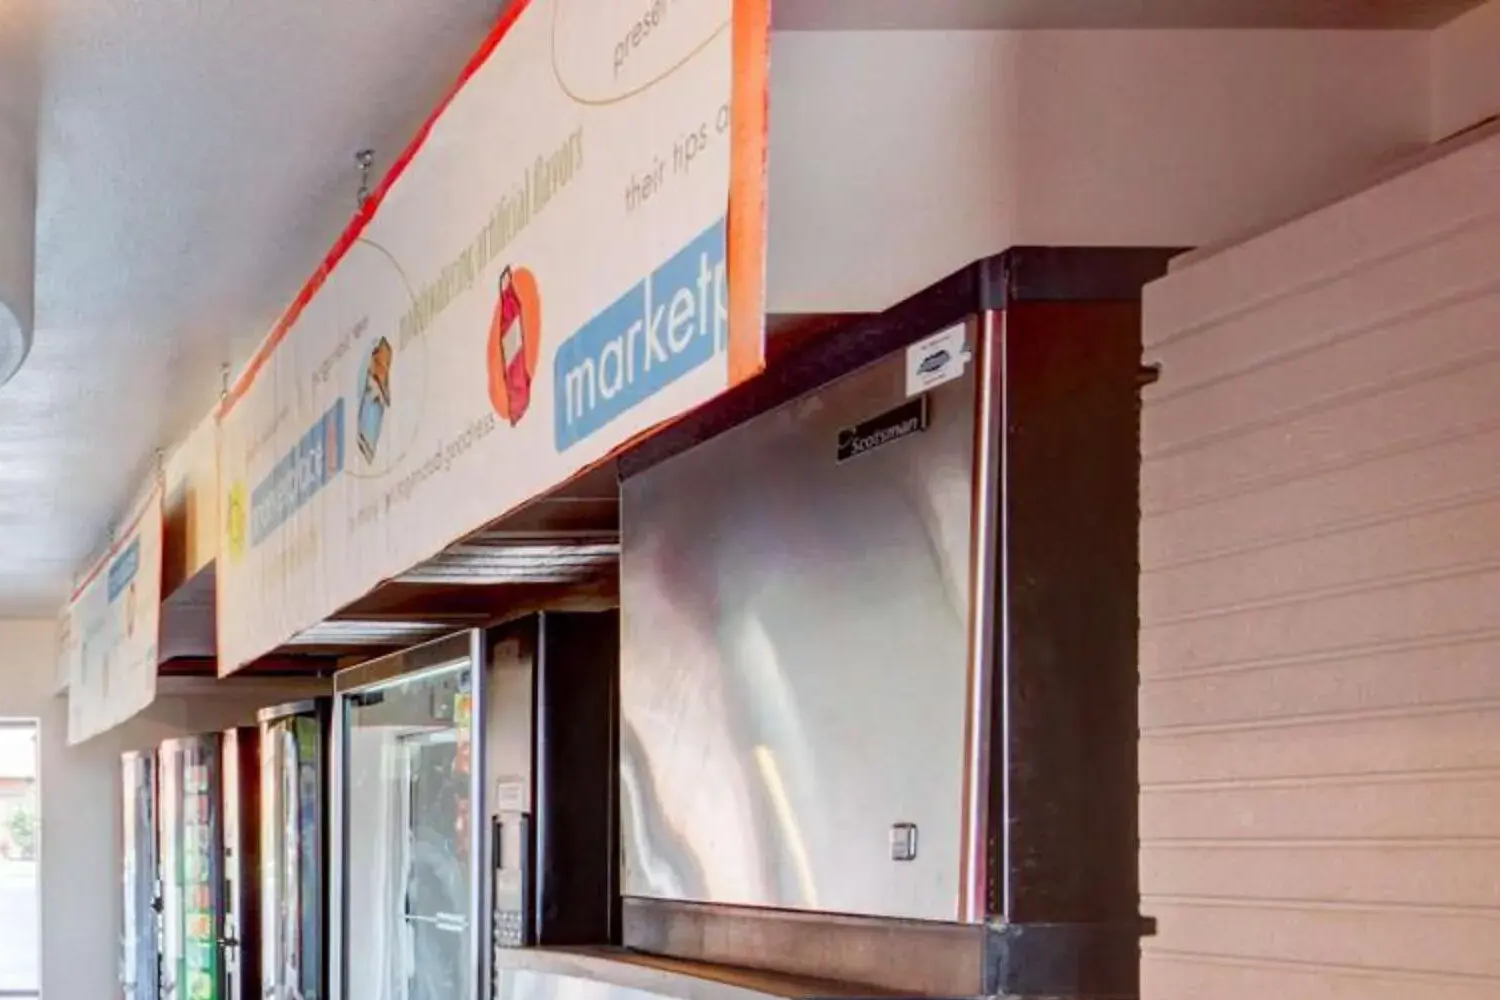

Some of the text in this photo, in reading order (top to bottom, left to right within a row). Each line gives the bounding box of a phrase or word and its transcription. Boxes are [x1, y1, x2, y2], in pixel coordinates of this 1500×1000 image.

[533, 126, 584, 216] flavors
[625, 155, 665, 213] their
[673, 122, 707, 174] tips
[851, 417, 919, 453] Scotsman
